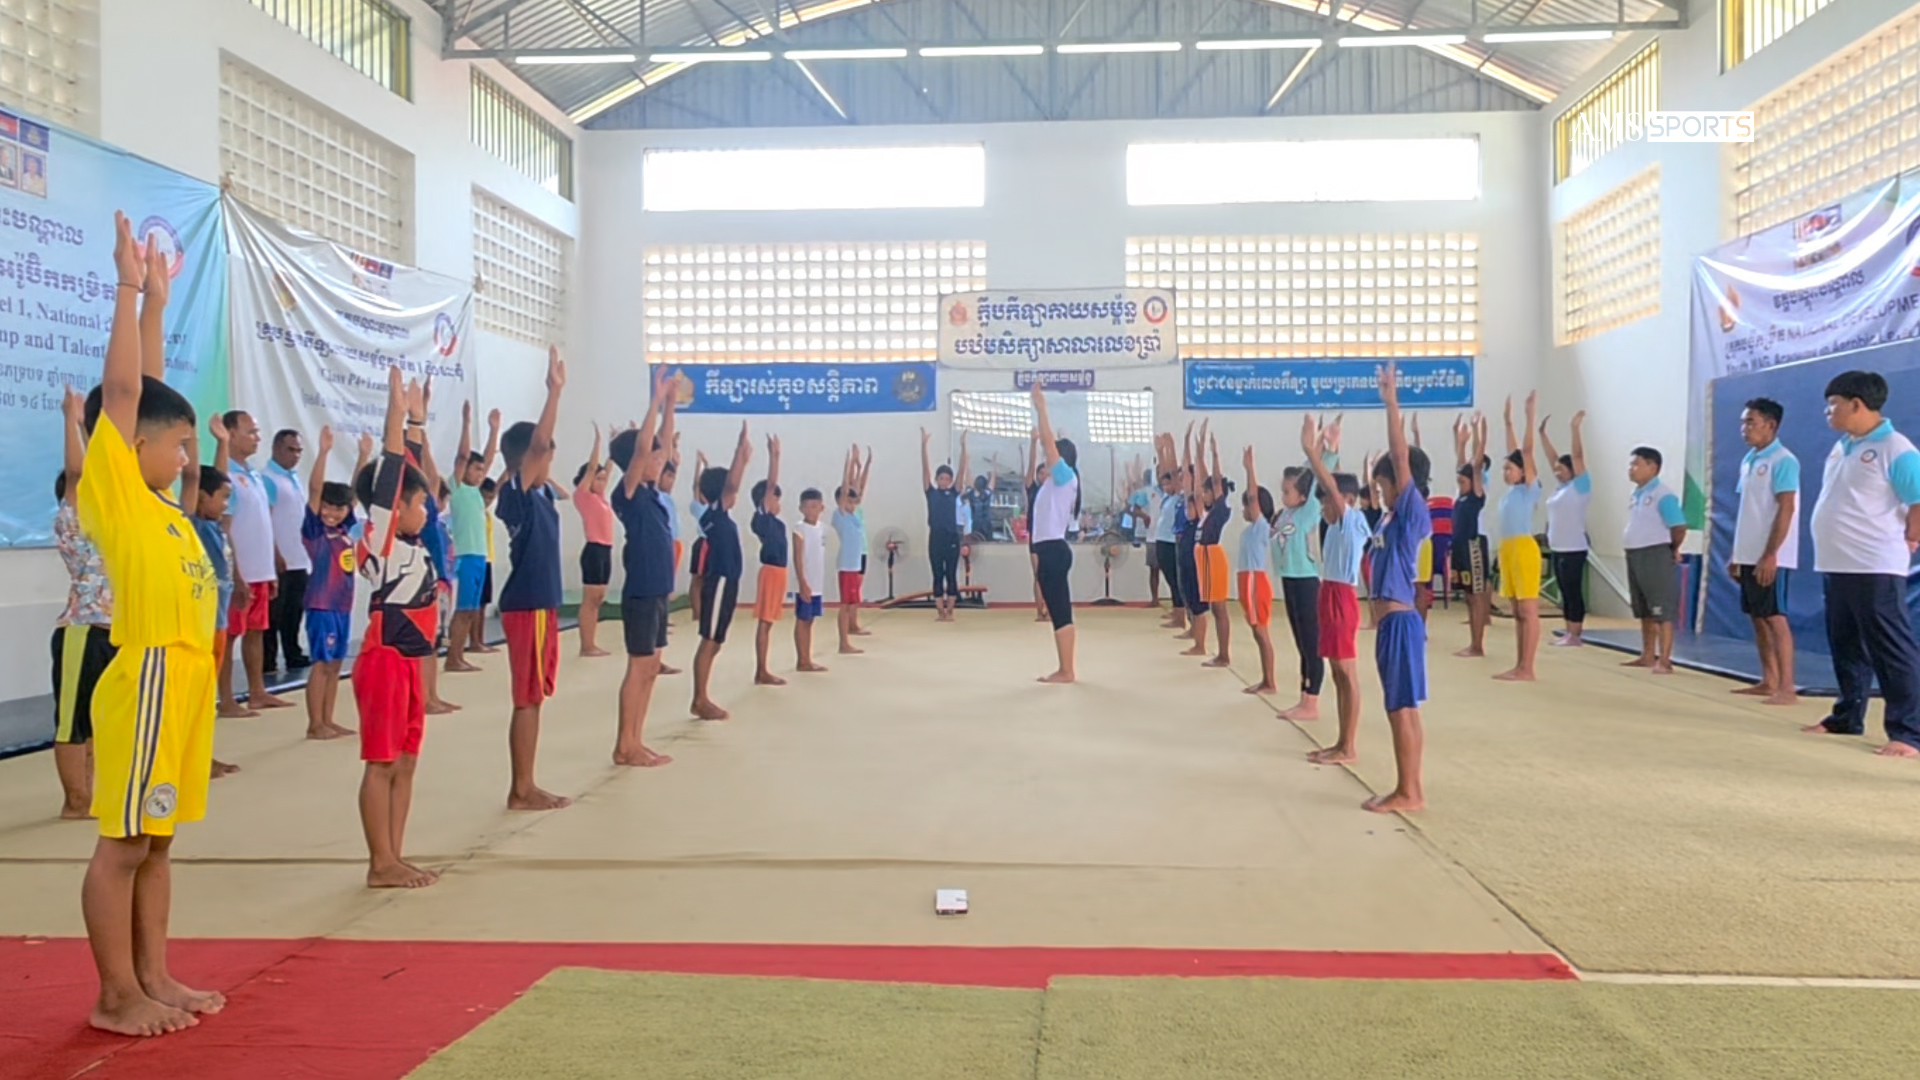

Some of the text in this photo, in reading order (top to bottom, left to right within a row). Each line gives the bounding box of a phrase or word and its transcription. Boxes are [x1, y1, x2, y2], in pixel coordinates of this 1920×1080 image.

[0, 207, 84, 246] ះបណ្តាល
[37, 301, 100, 331] National
[0, 328, 106, 358] mp and Talent
